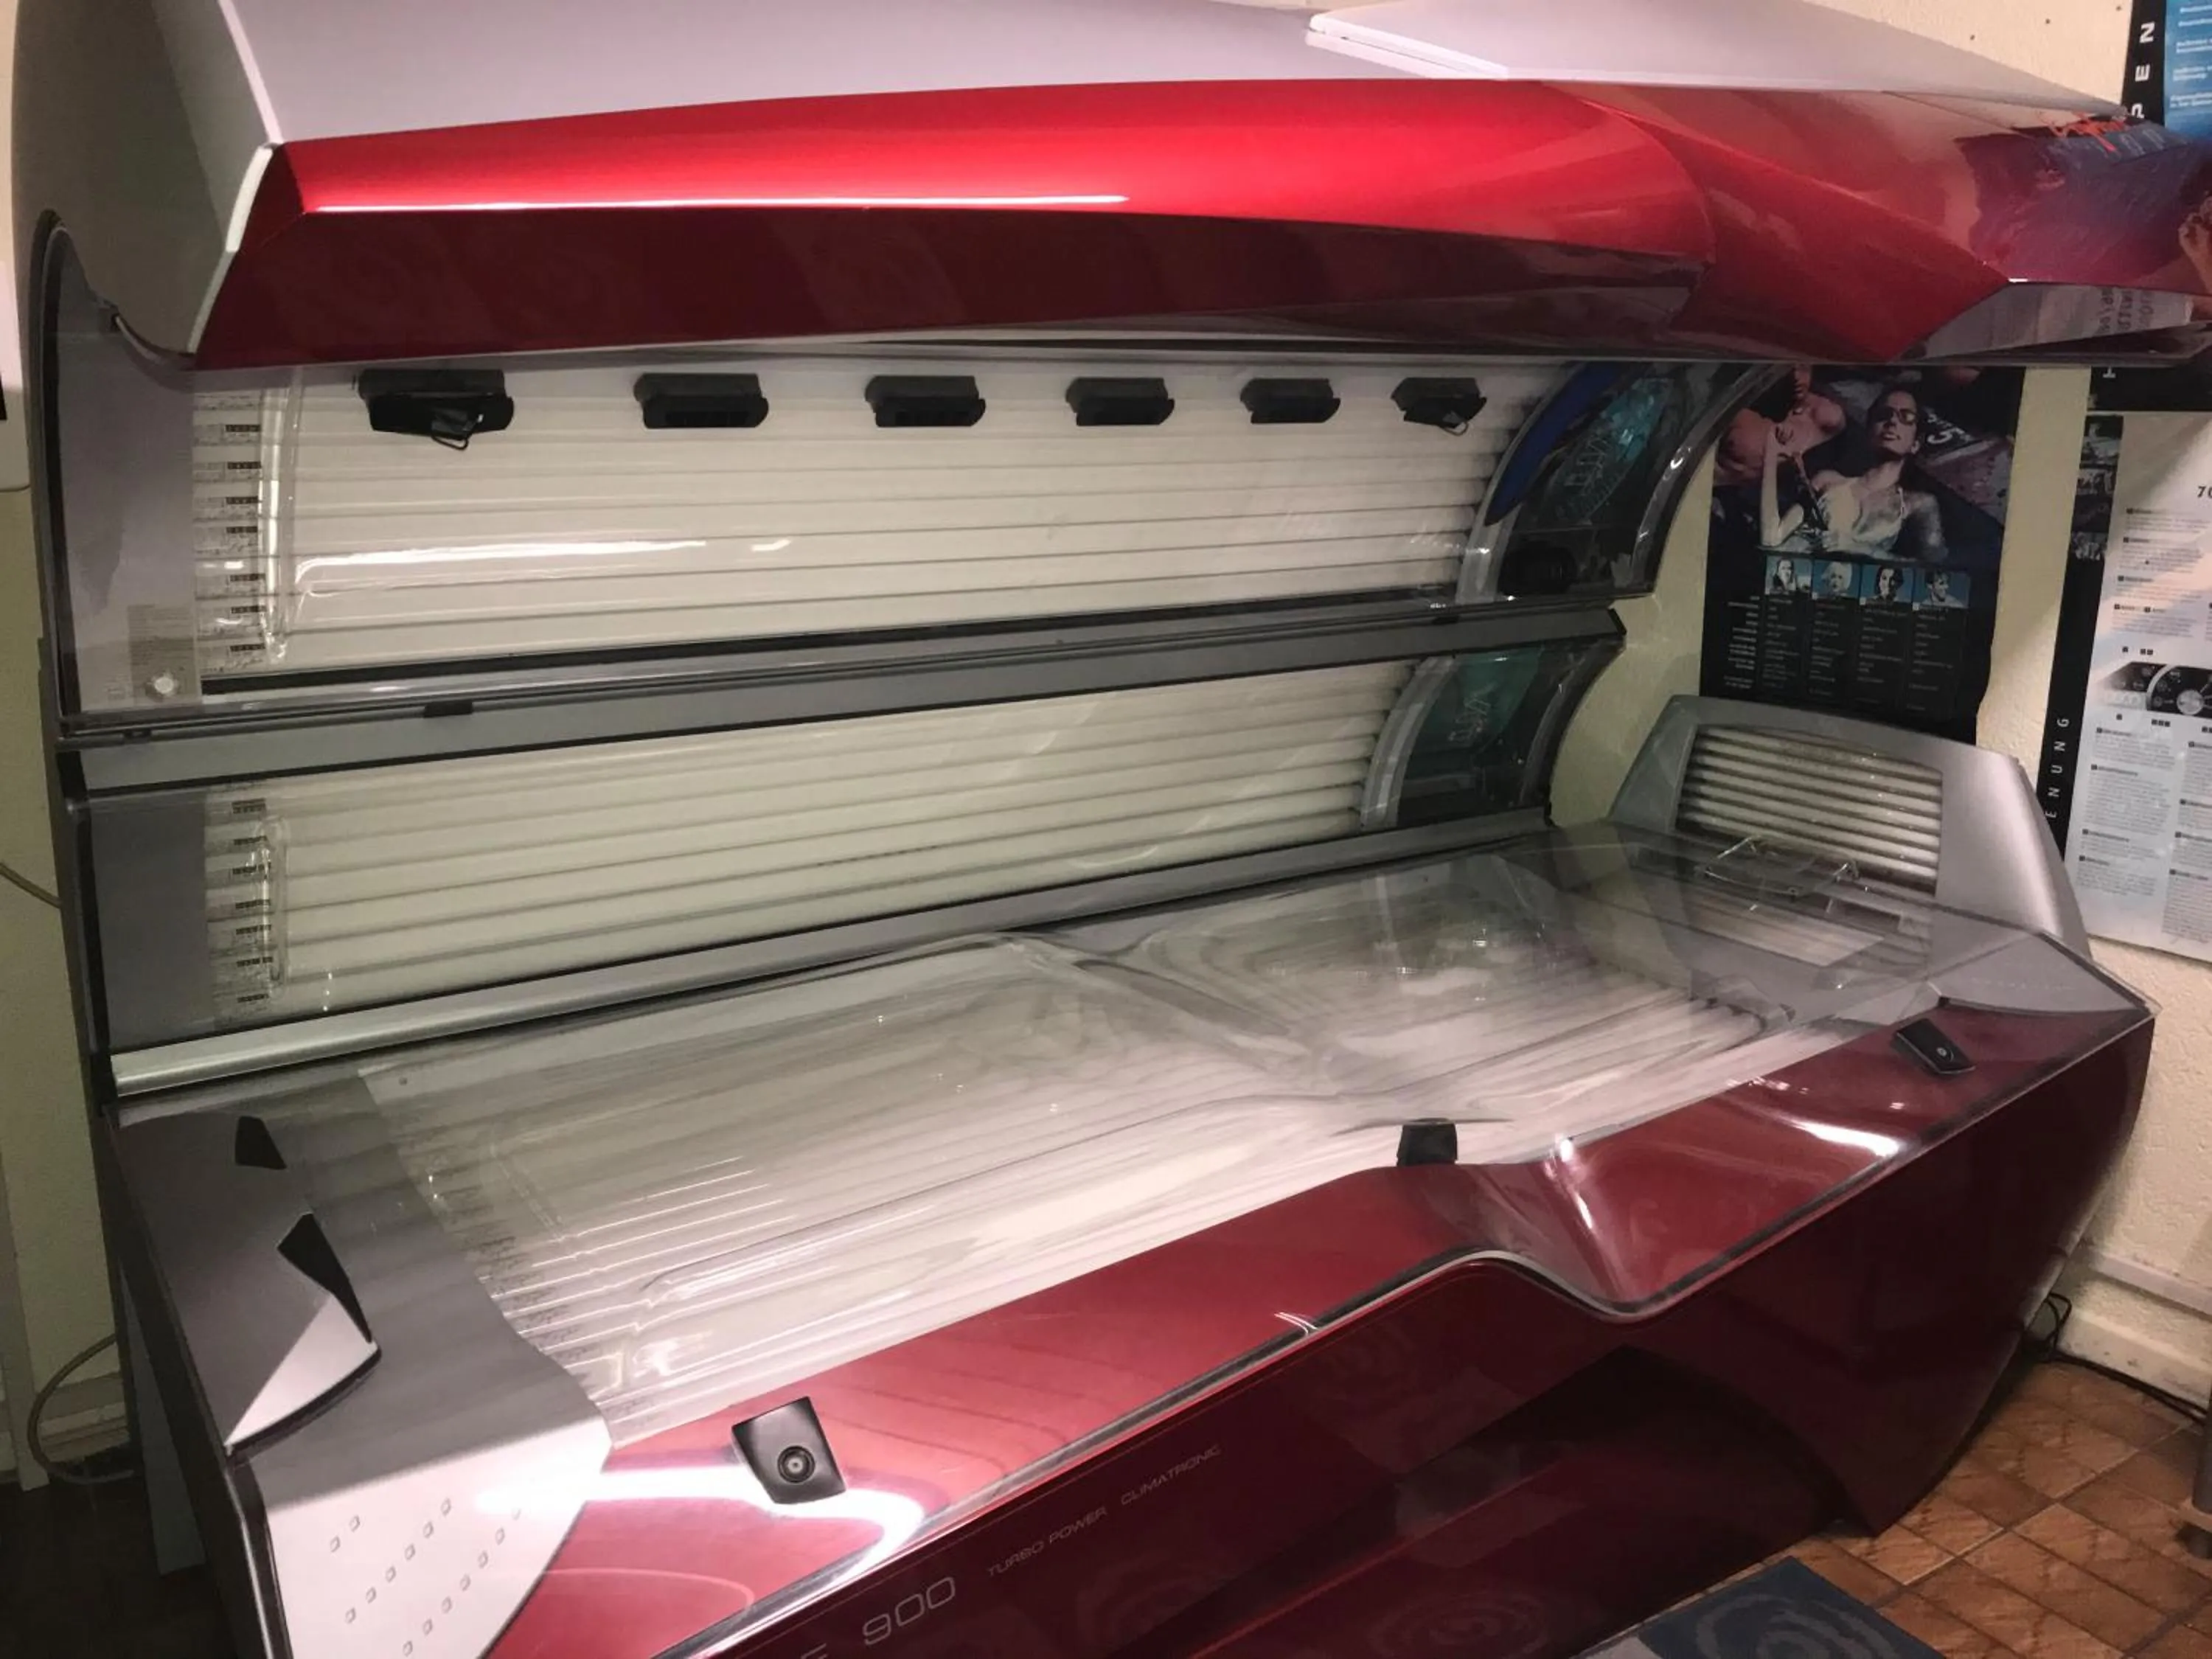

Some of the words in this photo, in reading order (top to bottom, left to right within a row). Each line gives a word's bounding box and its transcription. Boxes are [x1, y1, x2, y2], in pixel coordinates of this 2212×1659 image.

[863, 1576, 956, 1645] 900
[987, 1540, 1044, 1576] TURBO
[1049, 1506, 1107, 1544] POWER
[1120, 1444, 1222, 1505] CLIMATRONIC
